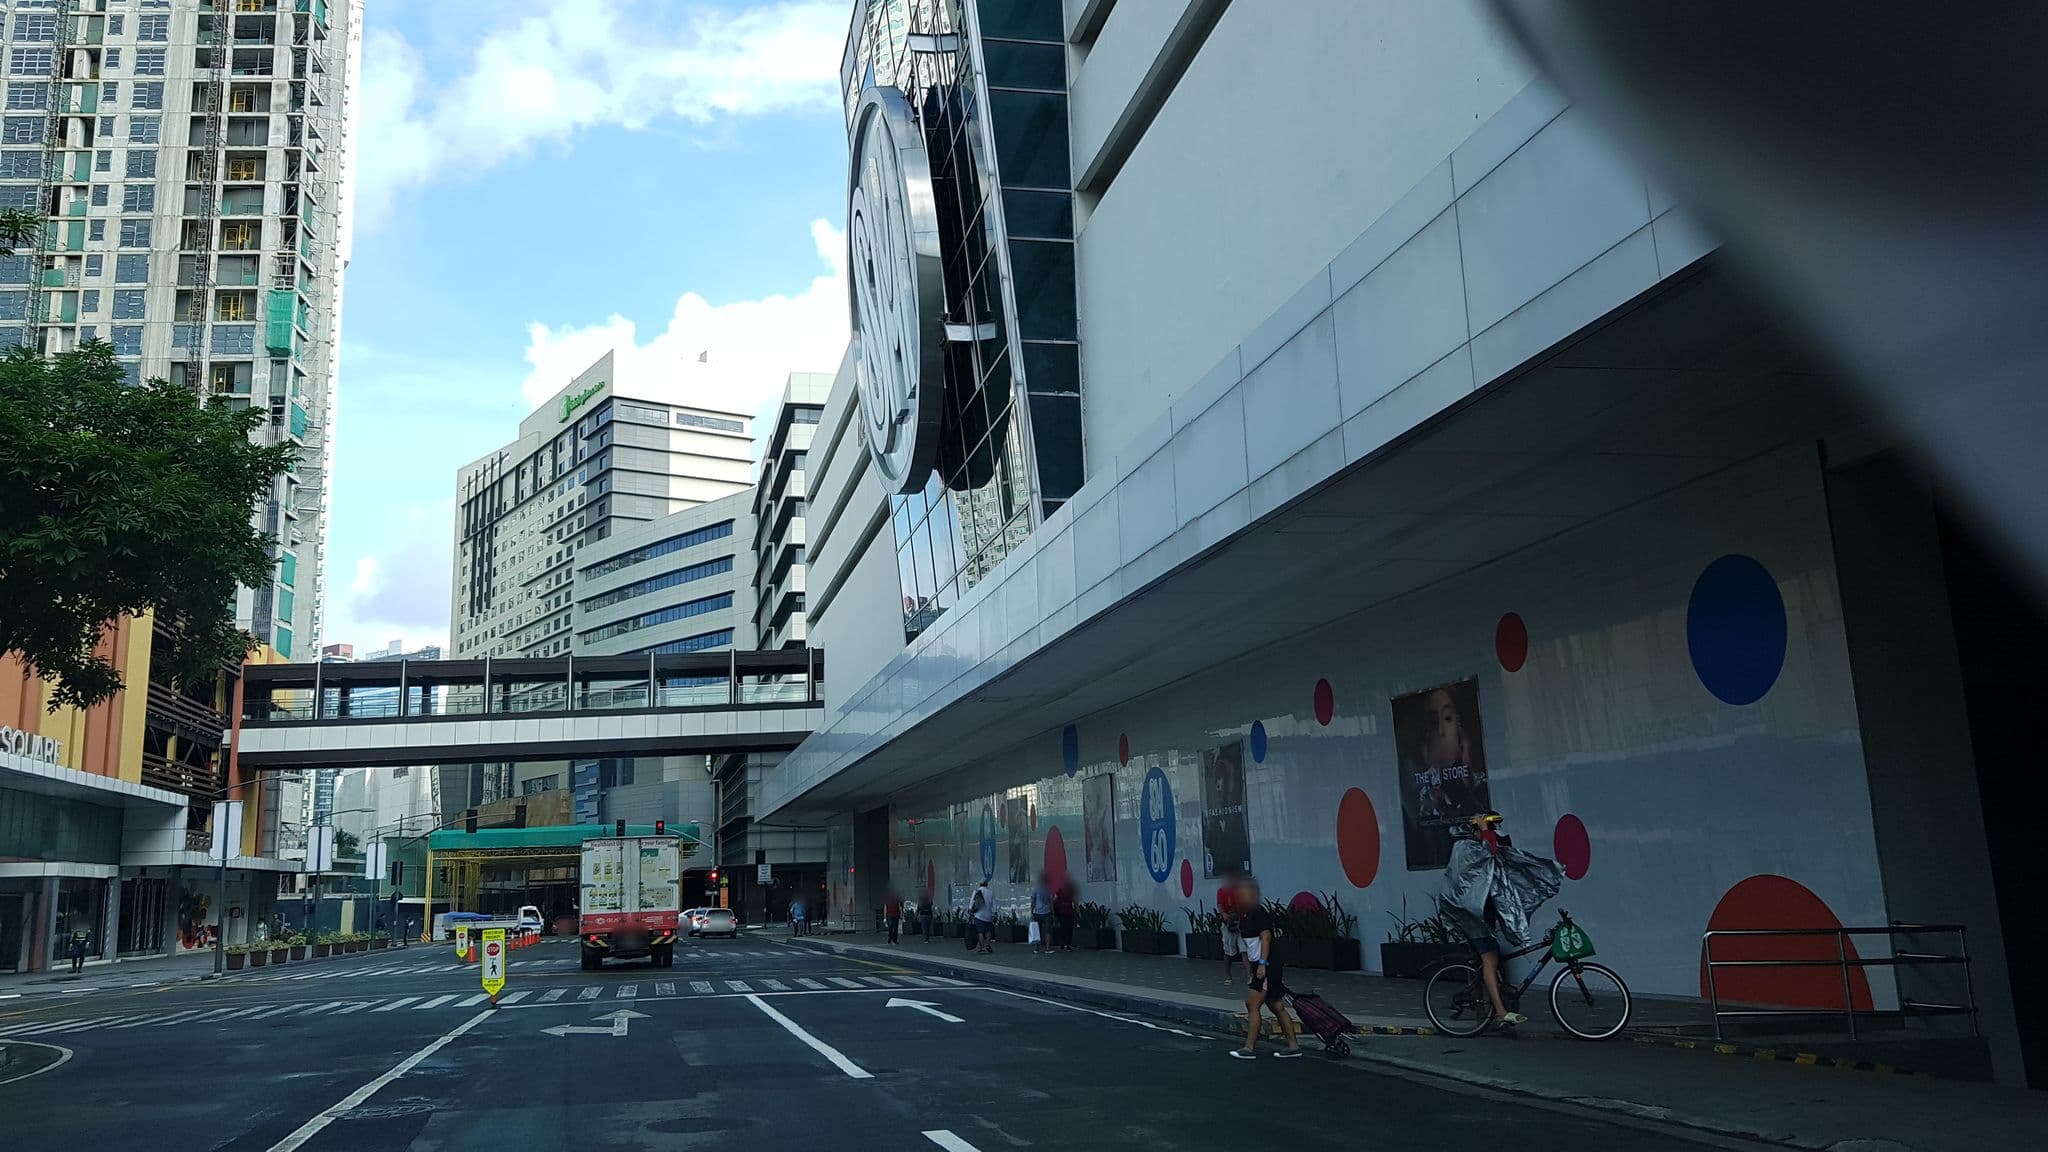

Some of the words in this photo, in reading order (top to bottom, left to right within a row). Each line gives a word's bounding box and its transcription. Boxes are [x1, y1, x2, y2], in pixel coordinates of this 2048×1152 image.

[2, 725, 64, 764] SQUARE
[1414, 771, 1429, 784] THE
[1442, 765, 1469, 781] STORE
[1150, 828, 1167, 873] 60
